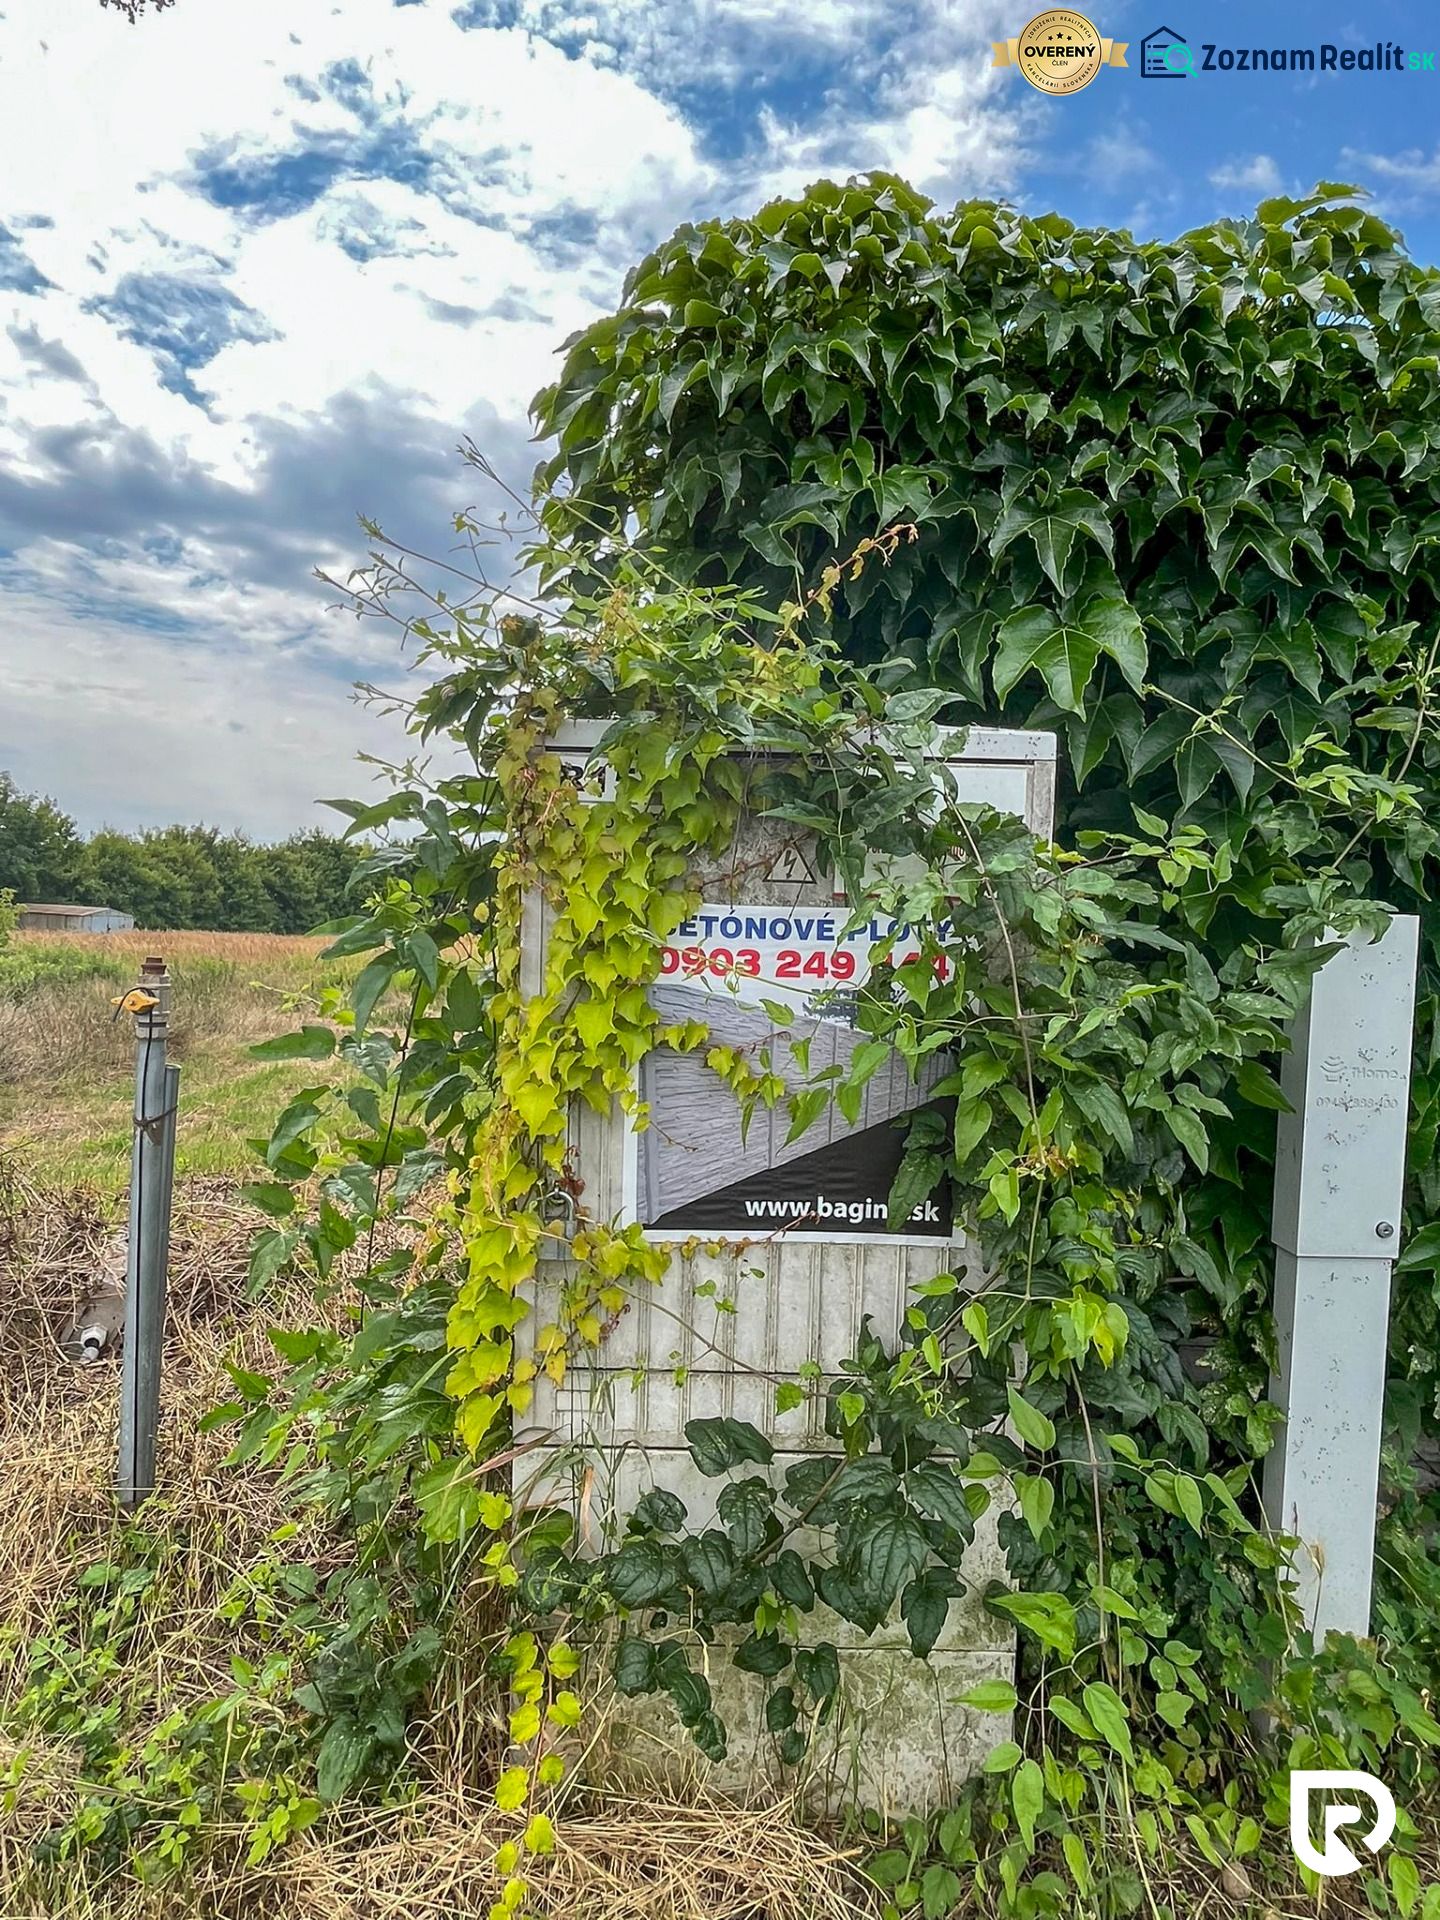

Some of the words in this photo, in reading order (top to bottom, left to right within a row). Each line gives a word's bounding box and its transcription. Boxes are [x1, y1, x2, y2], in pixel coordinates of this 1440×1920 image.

[667, 909, 835, 941] ETÓNOVÉ
[661, 947, 761, 976] 0903
[776, 950, 855, 980] 249
[745, 1196, 940, 1224] www.bagin.sk
